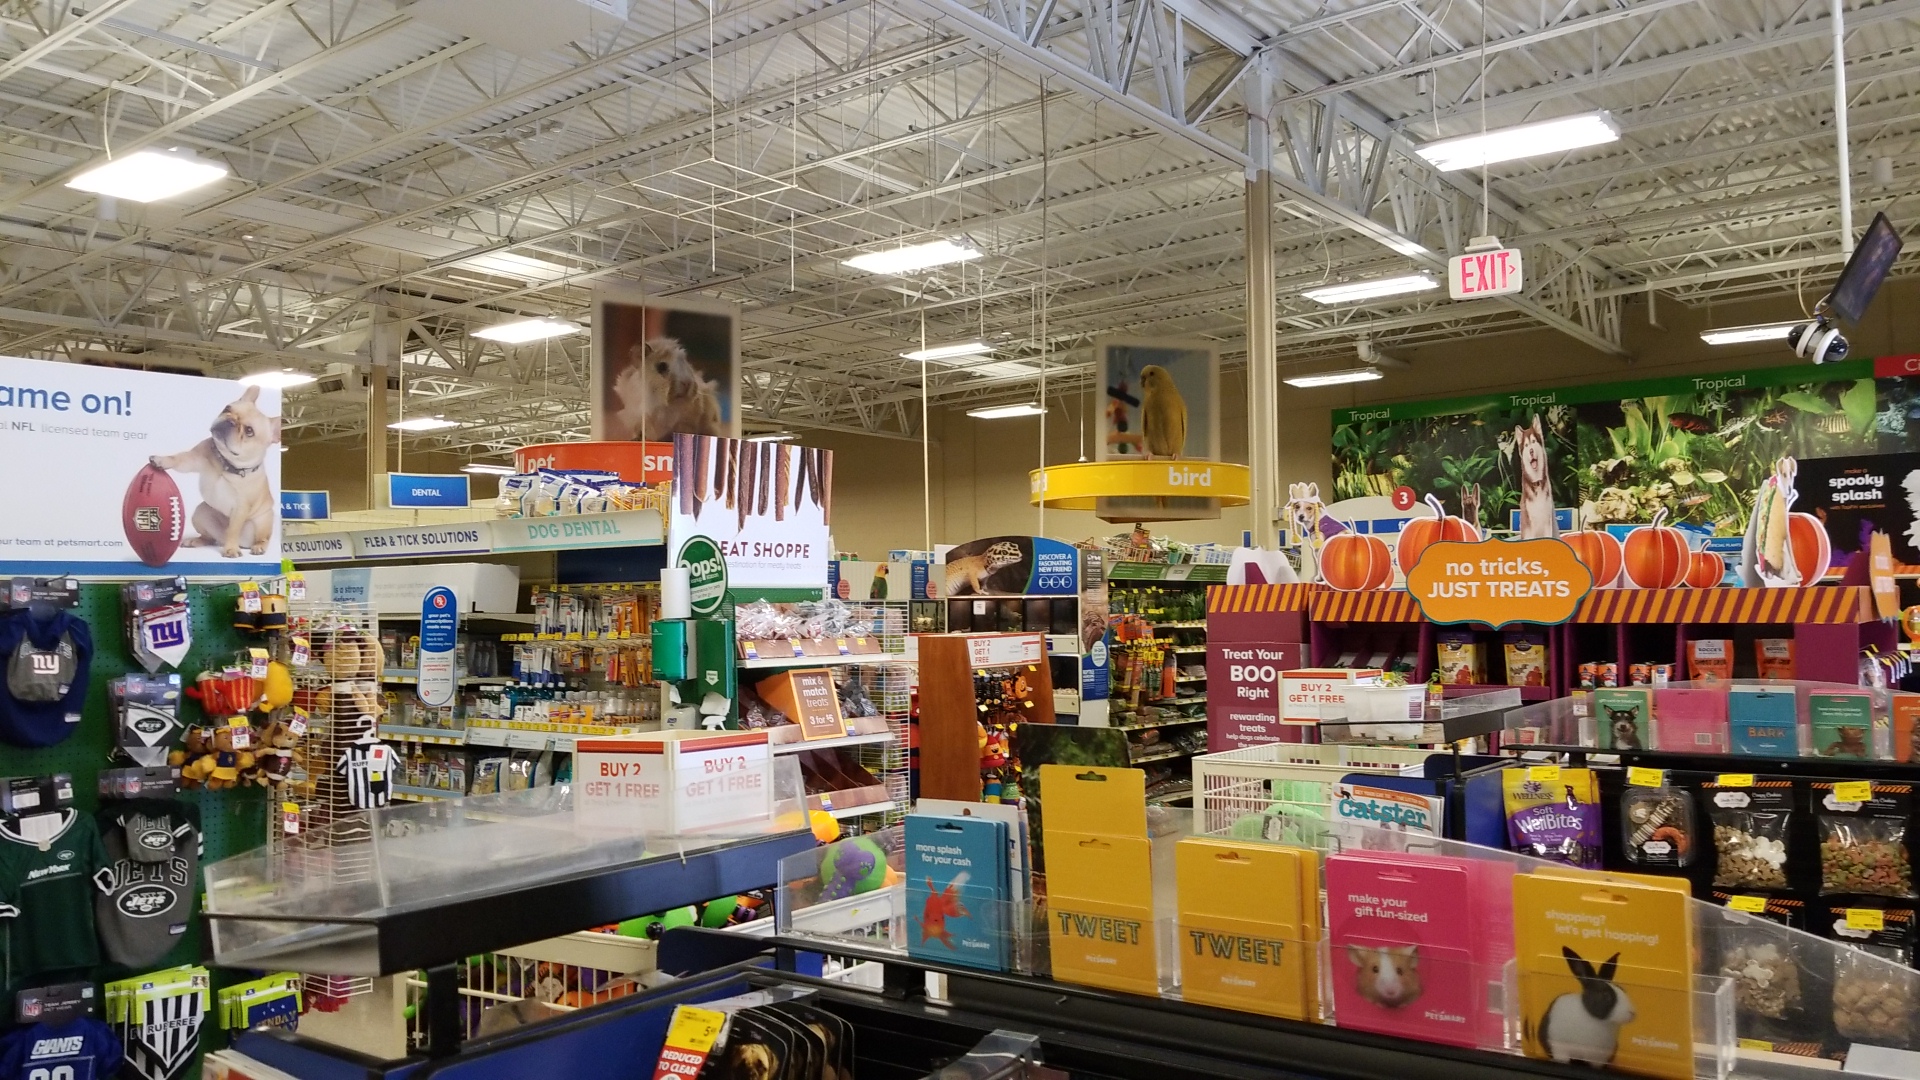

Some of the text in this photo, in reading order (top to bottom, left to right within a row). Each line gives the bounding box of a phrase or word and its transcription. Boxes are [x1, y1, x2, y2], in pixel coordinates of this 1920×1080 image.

[1460, 252, 1510, 293] EXIT
[1692, 375, 1745, 391] Tropical
[0, 386, 131, 416] ame on!
[1510, 393, 1555, 408] Tropical
[1349, 408, 1390, 422] Tropical
[11, 421, 35, 432] NFL
[41, 424, 89, 436] licensed
[92, 428, 120, 438] team
[123, 431, 147, 441] gear
[527, 453, 556, 473] pet
[1169, 467, 1211, 487] bird
[1828, 474, 1884, 489] spooky
[412, 489, 442, 497] DENTAL
[1399, 492, 1408, 505] 3
[1831, 489, 1882, 504] splash
[528, 519, 621, 540] DOG DENTAL
[16, 538, 41, 546] team
[57, 539, 123, 547] petsmart.com
[281, 539, 342, 553] ICK SOLUTIONS
[364, 530, 478, 548] FLEA & TICK SOLUTIONS
[721, 541, 810, 558] EAT SHOPPE
[1446, 557, 1549, 577] no tricks,
[1427, 581, 1570, 598] JUST TREATS
[149, 620, 184, 649] ny
[1222, 649, 1284, 660] Treat Your
[31, 654, 59, 674] ny
[802, 676, 823, 686] mix &
[1230, 665, 1276, 682] BOO
[803, 687, 828, 697] match
[1237, 687, 1269, 700] Right
[1301, 684, 1332, 692] BUY 2
[806, 698, 829, 707] treats
[1319, 695, 1345, 703] FREE
[809, 714, 834, 725] 3 for $5
[1230, 713, 1276, 724] rewarding
[1239, 724, 1266, 733] treats
[1748, 727, 1785, 737] BARK
[600, 762, 641, 777] BUY 2
[704, 756, 747, 774] BUY 2
[586, 782, 659, 798] GET 1 FREE
[686, 773, 761, 797] GET 1 FREE
[1513, 792, 1554, 800] WELLNESS
[1339, 798, 1427, 829] Catster
[1533, 806, 1553, 816] Soft
[134, 815, 172, 834] JET
[916, 843, 962, 855] more splash
[922, 853, 972, 866] for your cash
[27, 867, 49, 880] New
[114, 857, 188, 891] JETS
[1348, 894, 1407, 908] make your
[1355, 906, 1428, 923] gift fun-sized
[1545, 910, 1606, 926] shopping?
[1058, 912, 1141, 945] TWEET
[1555, 923, 1659, 946] let's get hopping!
[1190, 931, 1284, 966] TWEET
[1424, 1010, 1466, 1024] PETSMART
[31, 1036, 84, 1055] GIANTS
[662, 1050, 703, 1065] REDUCED
[659, 1061, 697, 1076] TO CLEAR
